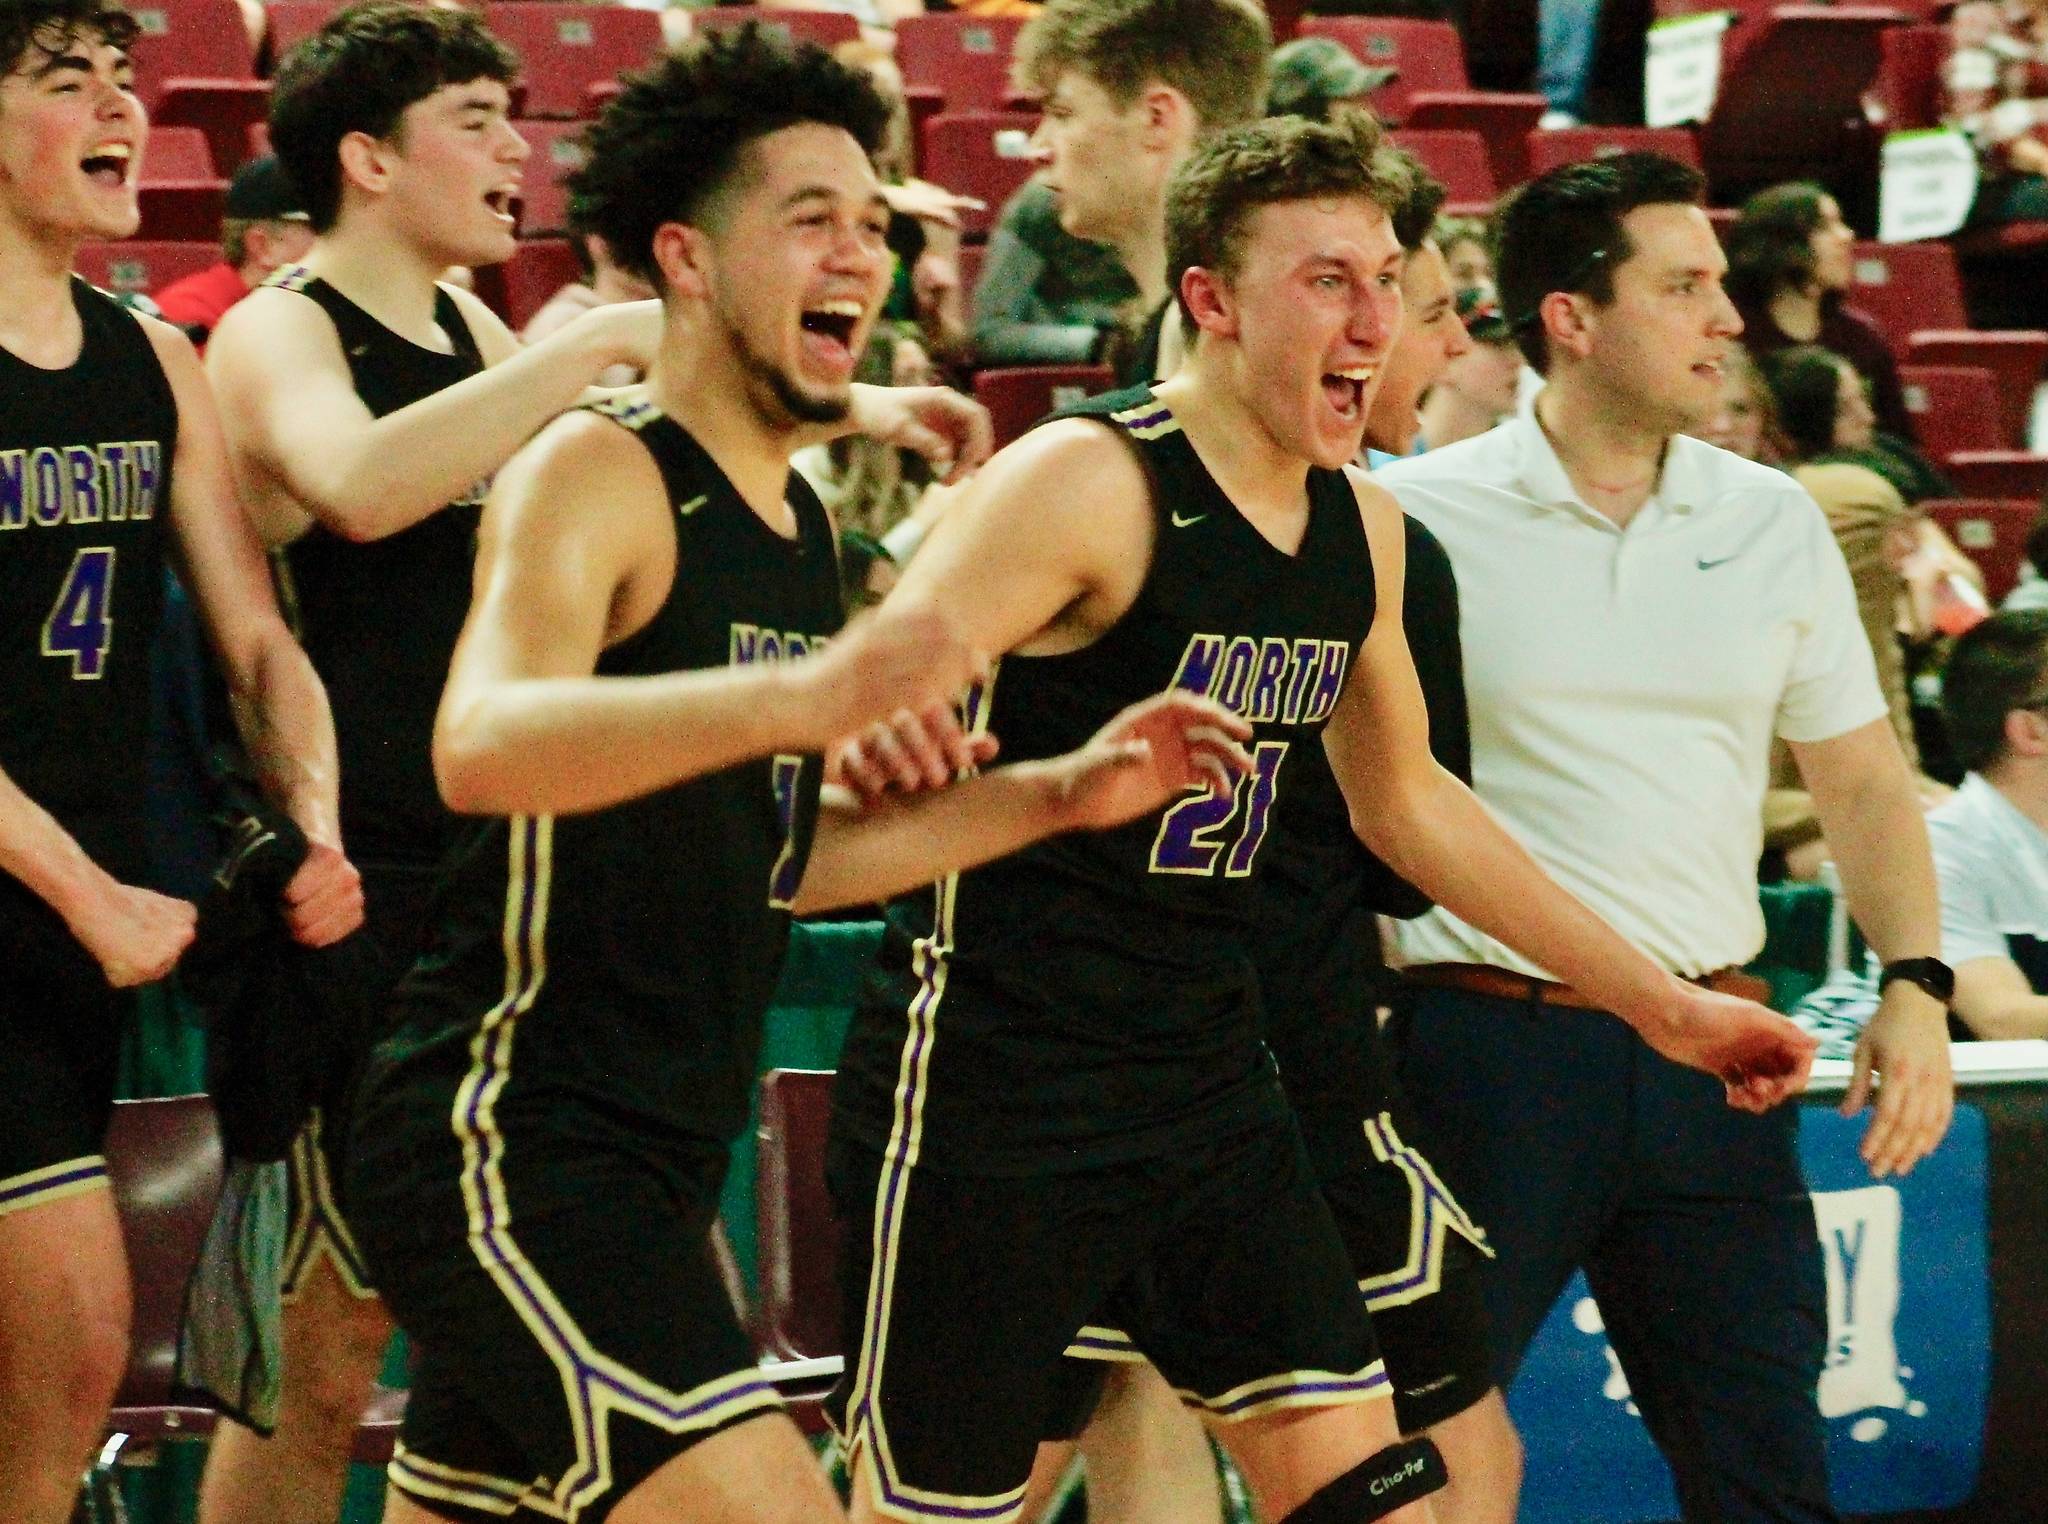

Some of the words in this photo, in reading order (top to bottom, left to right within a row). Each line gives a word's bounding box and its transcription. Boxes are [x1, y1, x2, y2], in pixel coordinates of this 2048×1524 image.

[0, 441, 160, 530] NORTH
[41, 546, 116, 680] 4
[1166, 633, 1349, 724] NORTH
[1148, 741, 1289, 878] 21
